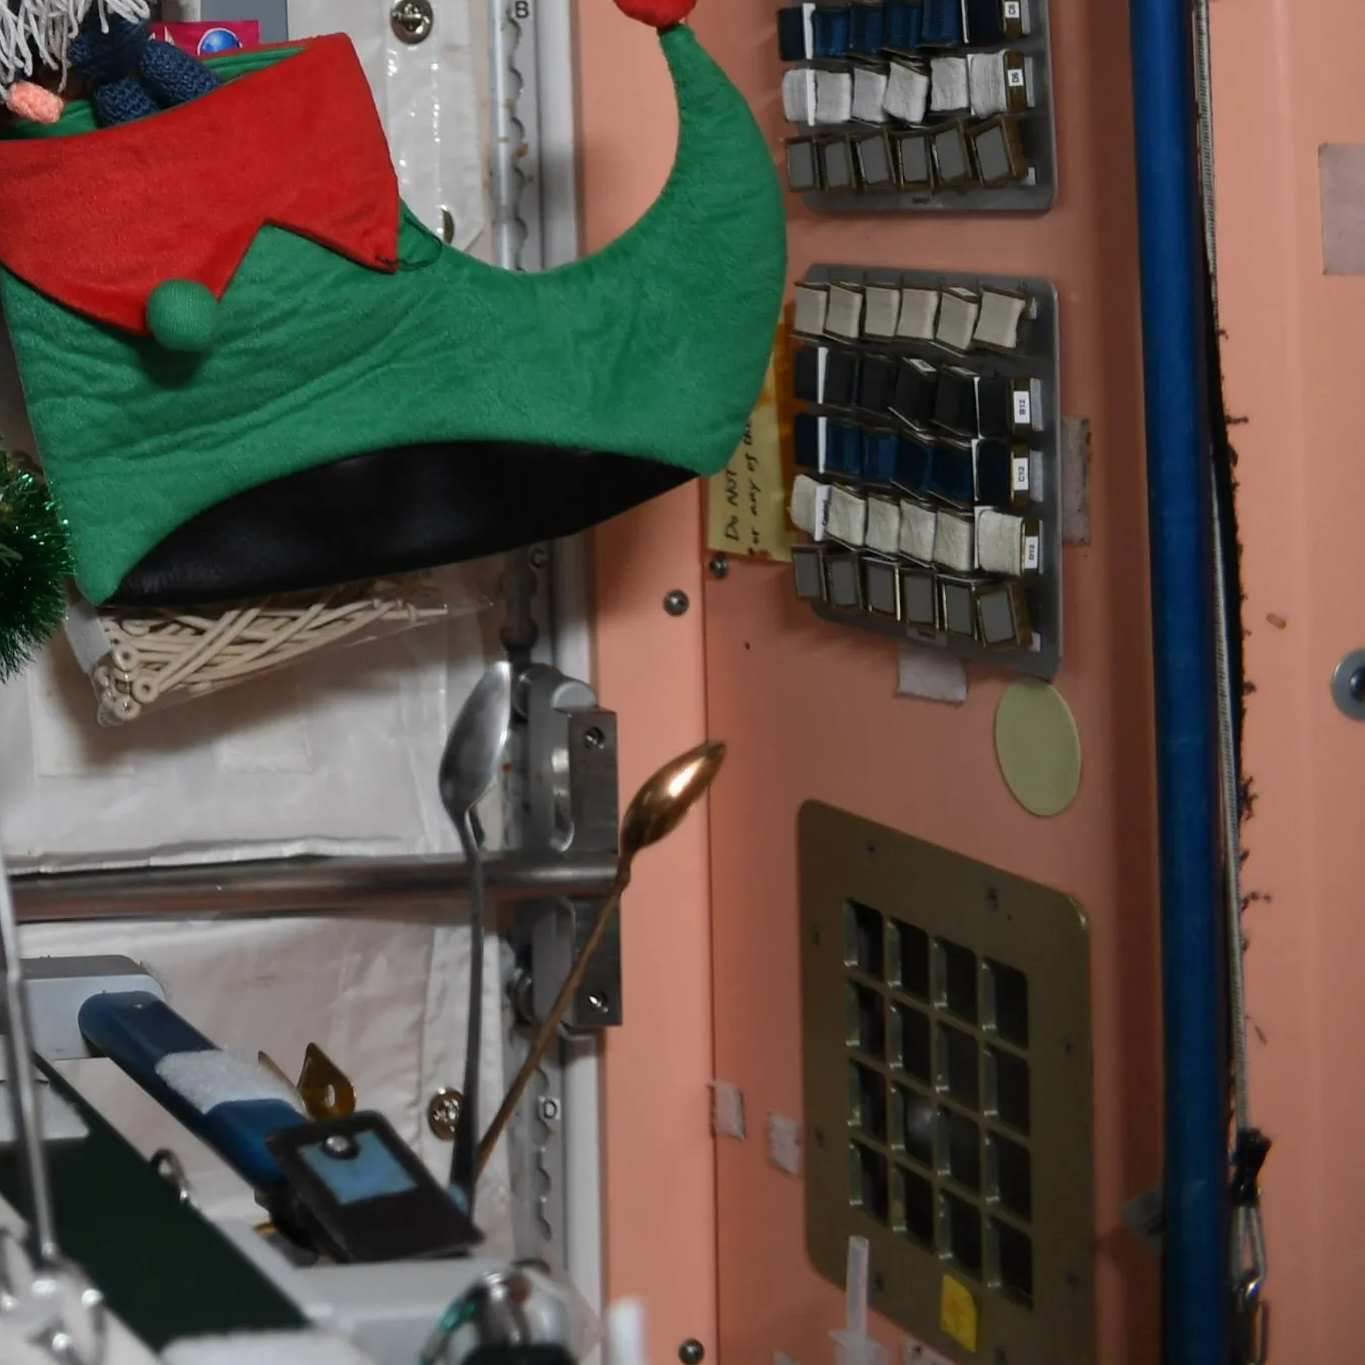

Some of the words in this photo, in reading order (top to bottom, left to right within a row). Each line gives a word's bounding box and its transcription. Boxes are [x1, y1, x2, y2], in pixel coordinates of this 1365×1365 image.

[515, 0, 530, 19] B
[725, 466, 740, 507] NOT
[749, 480, 762, 517] any
